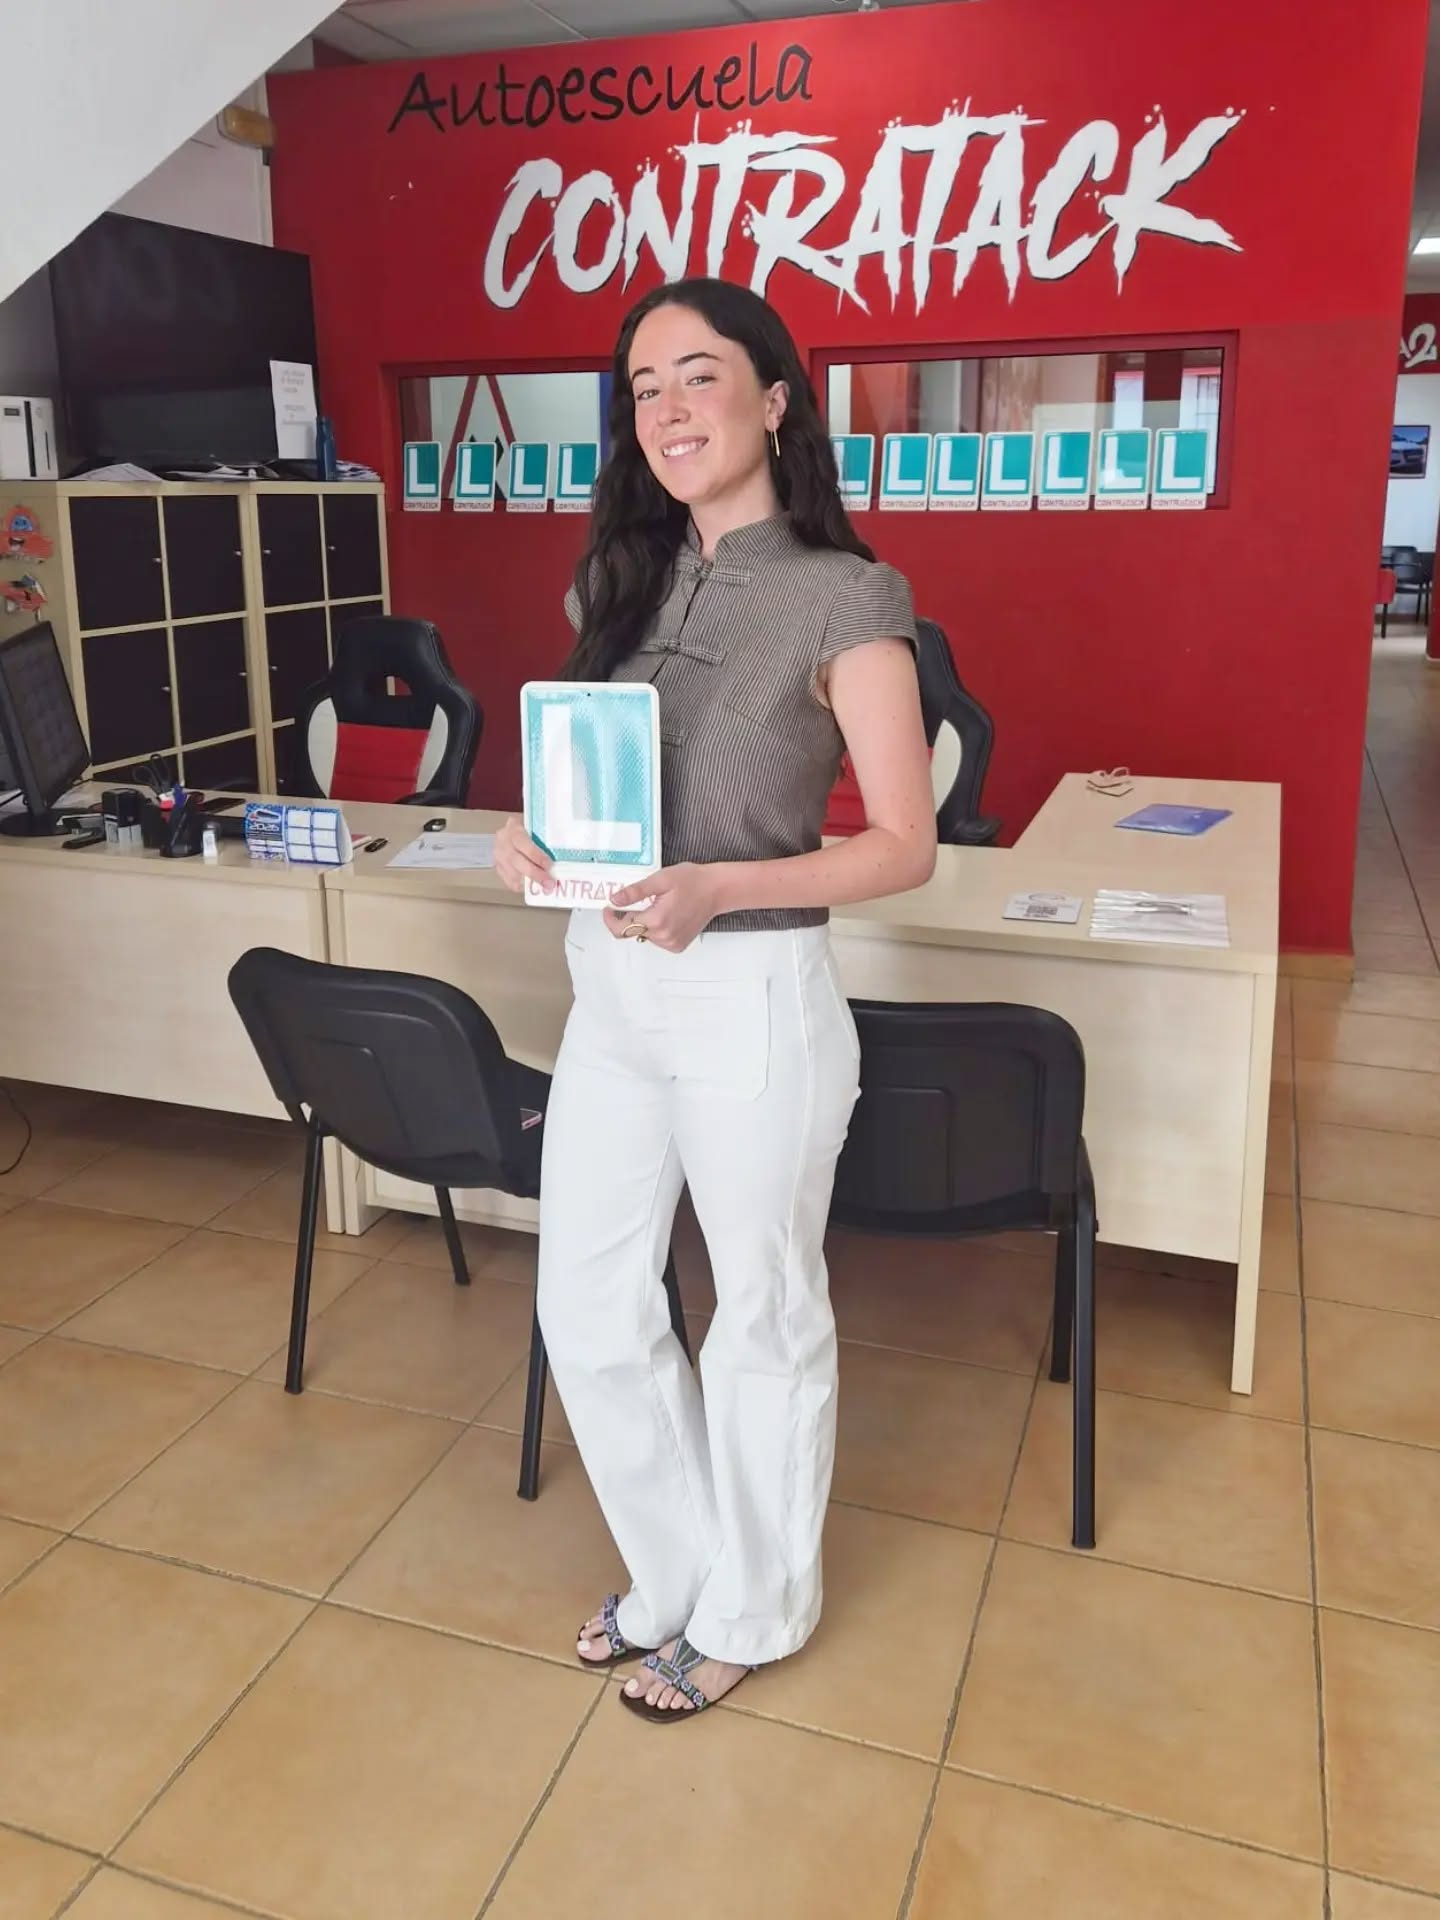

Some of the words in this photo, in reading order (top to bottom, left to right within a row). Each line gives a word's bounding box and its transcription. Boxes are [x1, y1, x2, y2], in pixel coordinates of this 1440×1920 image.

[388, 42, 814, 133] Autoescuela
[484, 98, 1246, 317] CONTRATACK
[409, 448, 435, 493] L
[461, 448, 490, 494] L
[514, 448, 543, 494] L
[560, 448, 592, 494] L
[887, 440, 923, 491] L
[937, 440, 974, 491] L
[989, 439, 1027, 491] L
[1046, 436, 1084, 489] L
[1104, 436, 1143, 489] L
[1161, 435, 1202, 489] L
[541, 703, 642, 853] L
